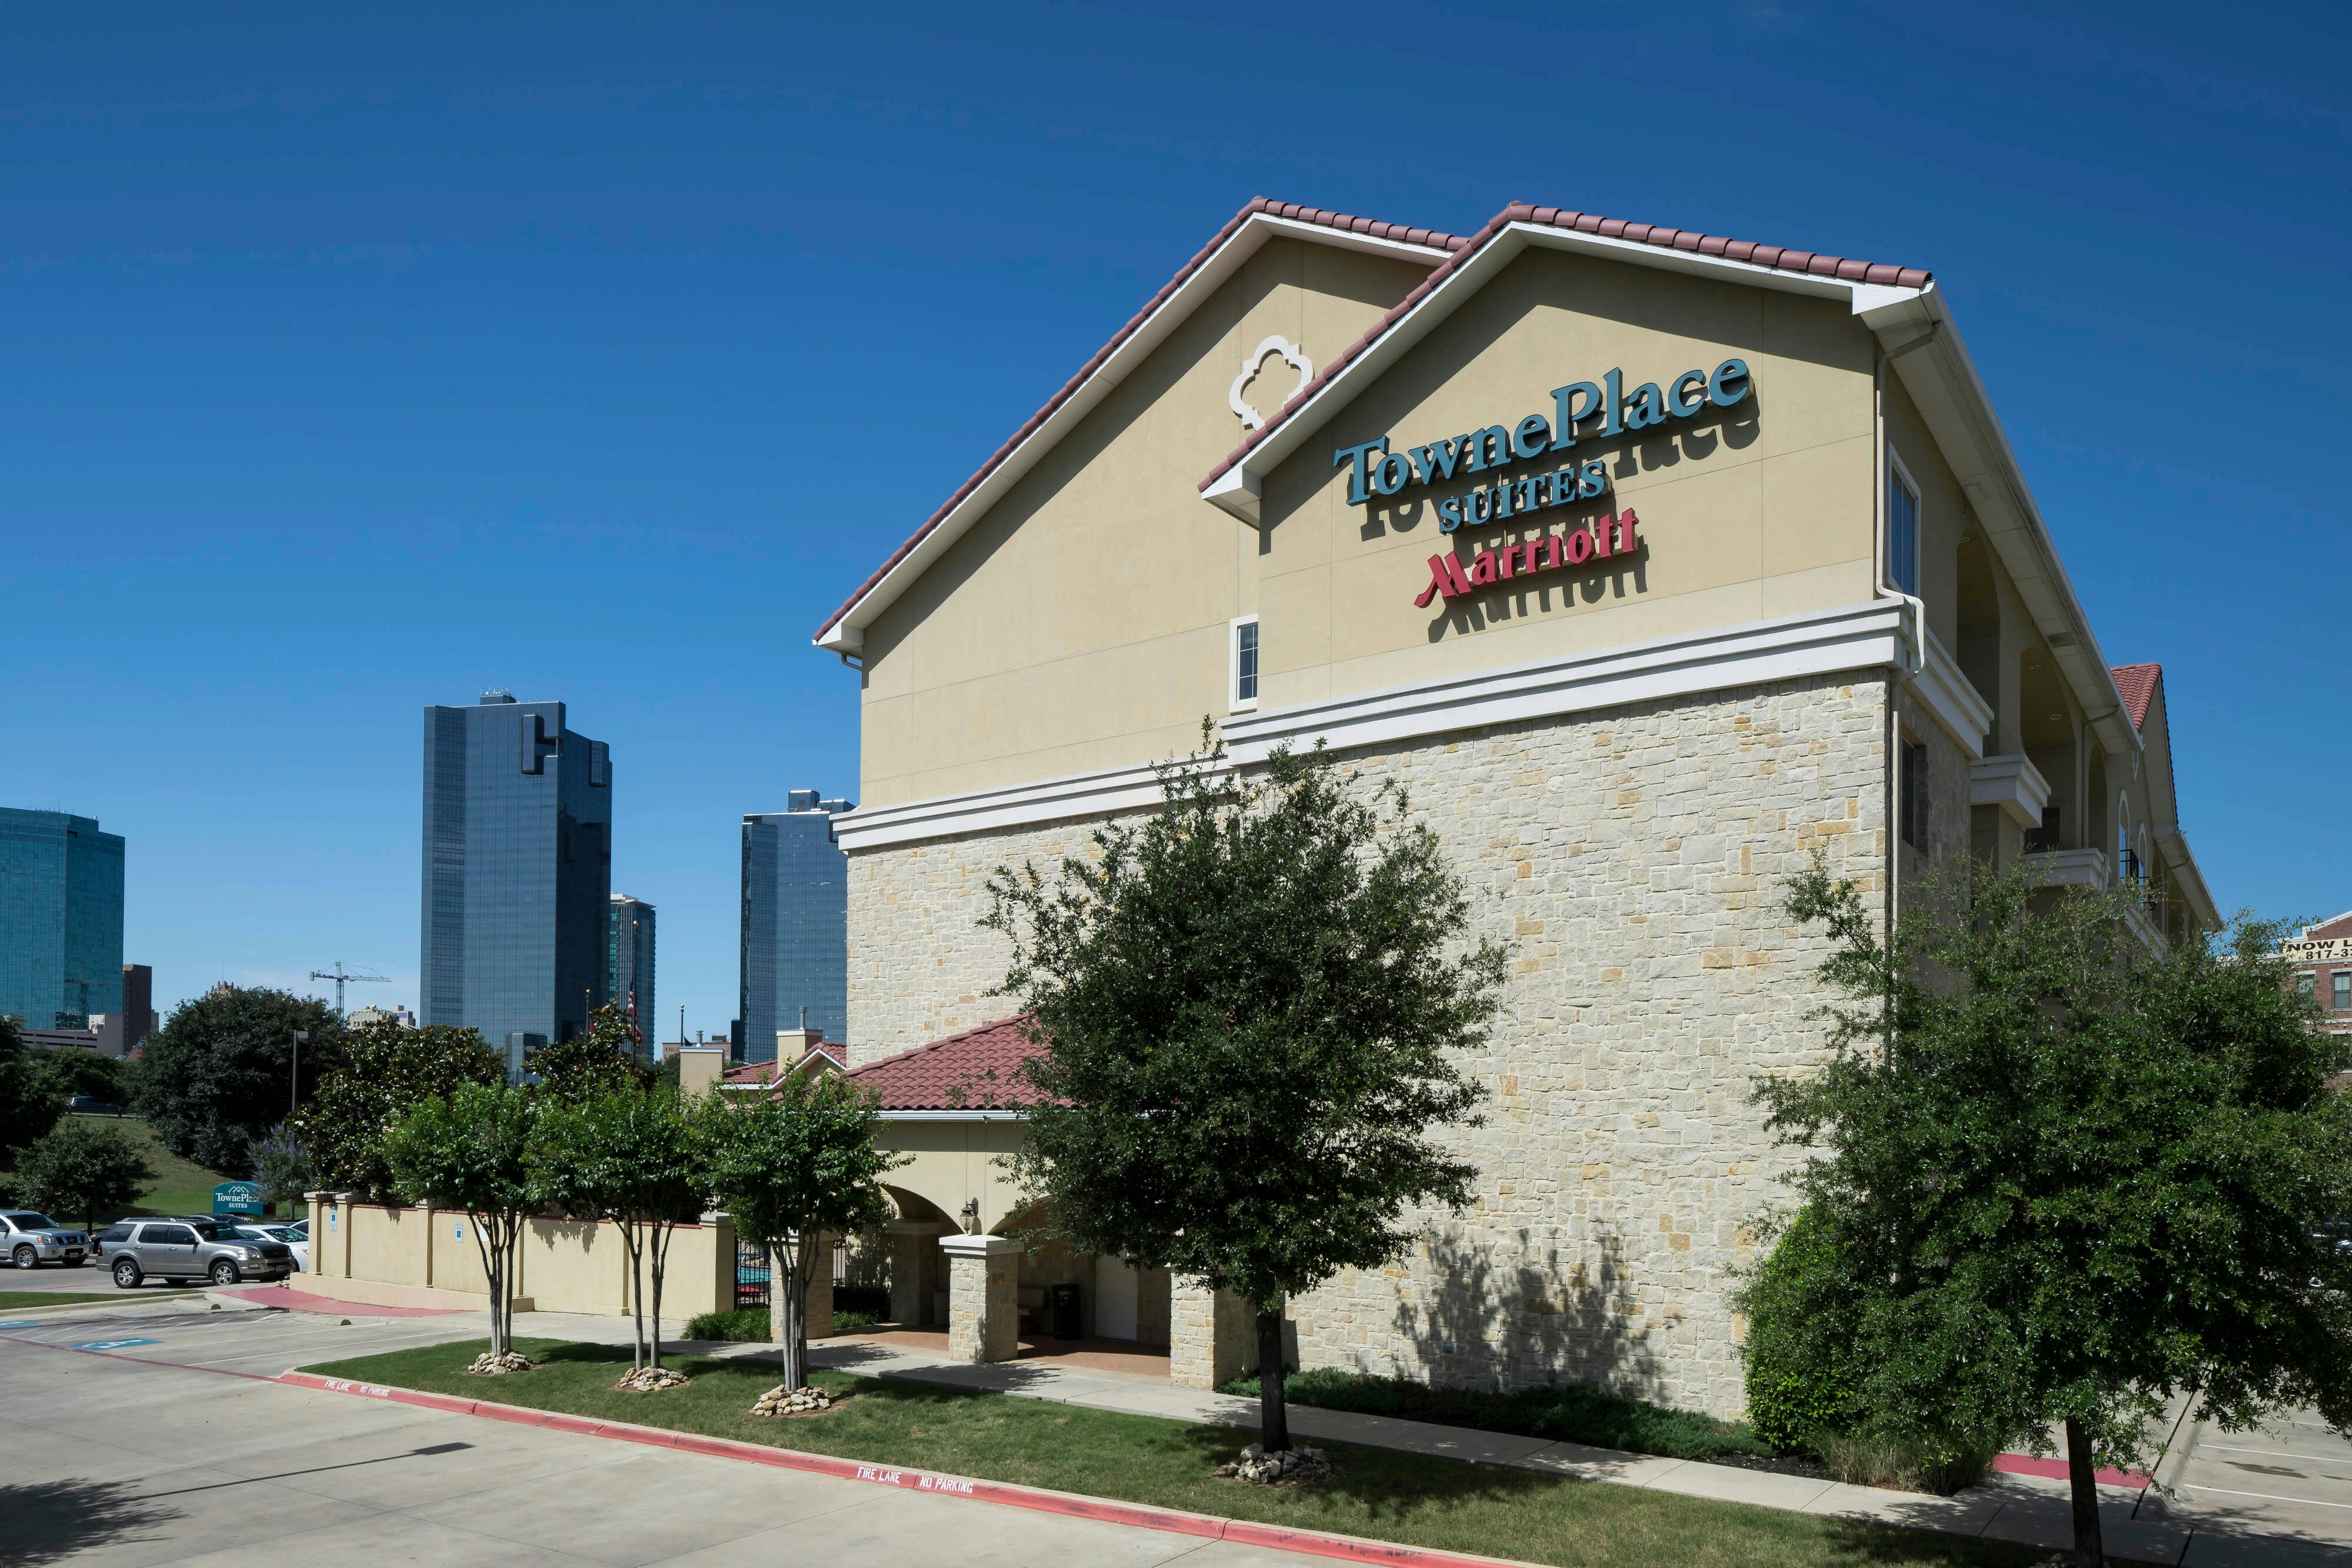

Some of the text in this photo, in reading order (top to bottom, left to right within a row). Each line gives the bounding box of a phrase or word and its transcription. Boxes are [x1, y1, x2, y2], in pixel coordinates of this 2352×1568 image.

[1333, 359, 1755, 506] TownePlace
[1439, 460, 1609, 534] SUITES
[1414, 507, 1639, 608] Marriott
[2287, 941, 2336, 951] NOW
[2306, 948, 2352, 959] 817-3
[325, 1380, 338, 1388] FIRE
[336, 1382, 352, 1391] LANE
[368, 1388, 390, 1397] PARKING
[857, 1466, 973, 1494] FIRE LANE NO PARKING
